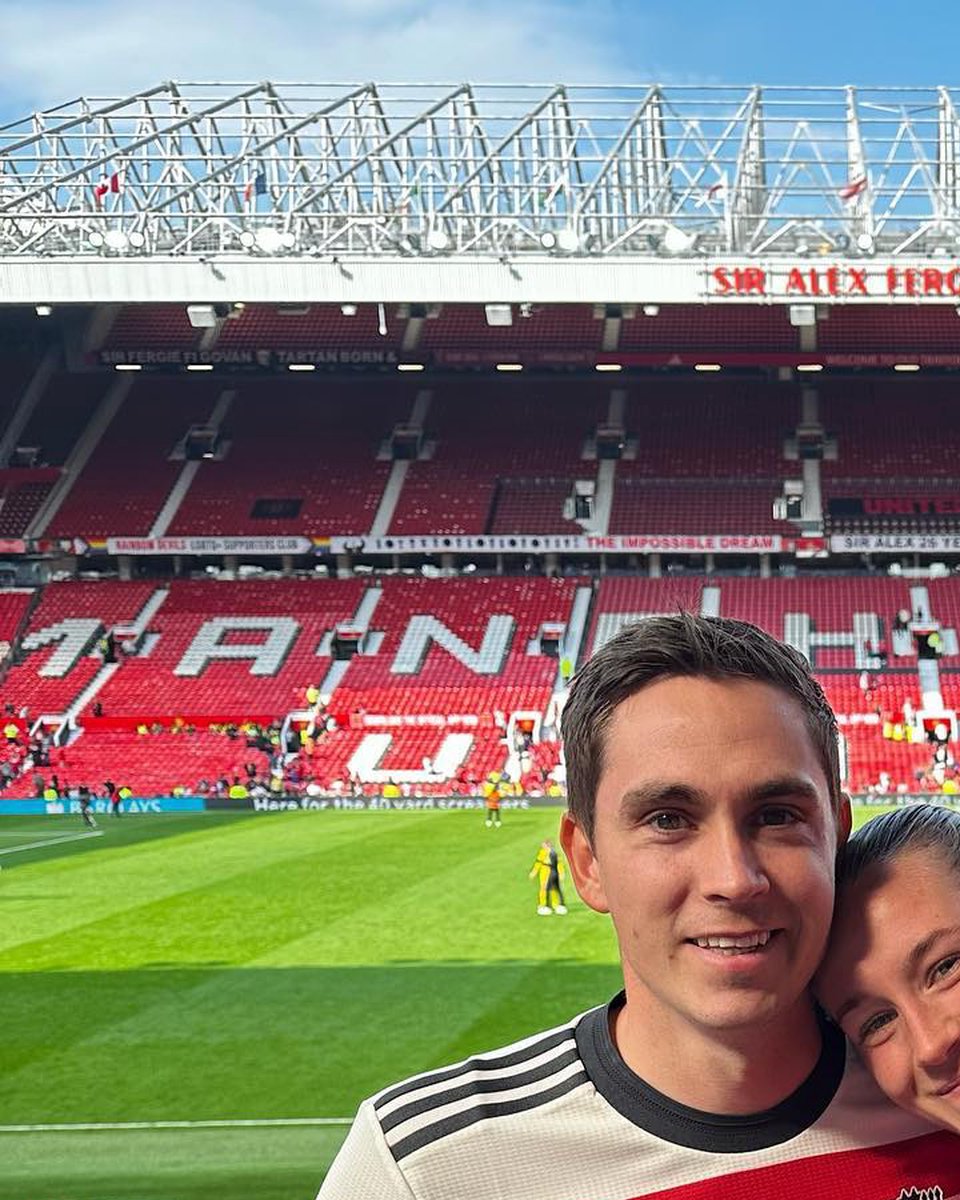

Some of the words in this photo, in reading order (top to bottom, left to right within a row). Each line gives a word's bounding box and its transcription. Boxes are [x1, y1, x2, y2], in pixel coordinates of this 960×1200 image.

[713, 267, 767, 294] SIR
[787, 267, 868, 295] ALEX
[586, 537, 617, 549] THE
[622, 537, 716, 549] IMPOSSIBLE
[845, 537, 870, 549] SIR
[874, 537, 914, 549] ALEX
[253, 797, 299, 811] Here
[301, 797, 330, 810] for
[334, 797, 365, 810] the
[437, 797, 531, 810] screaers
